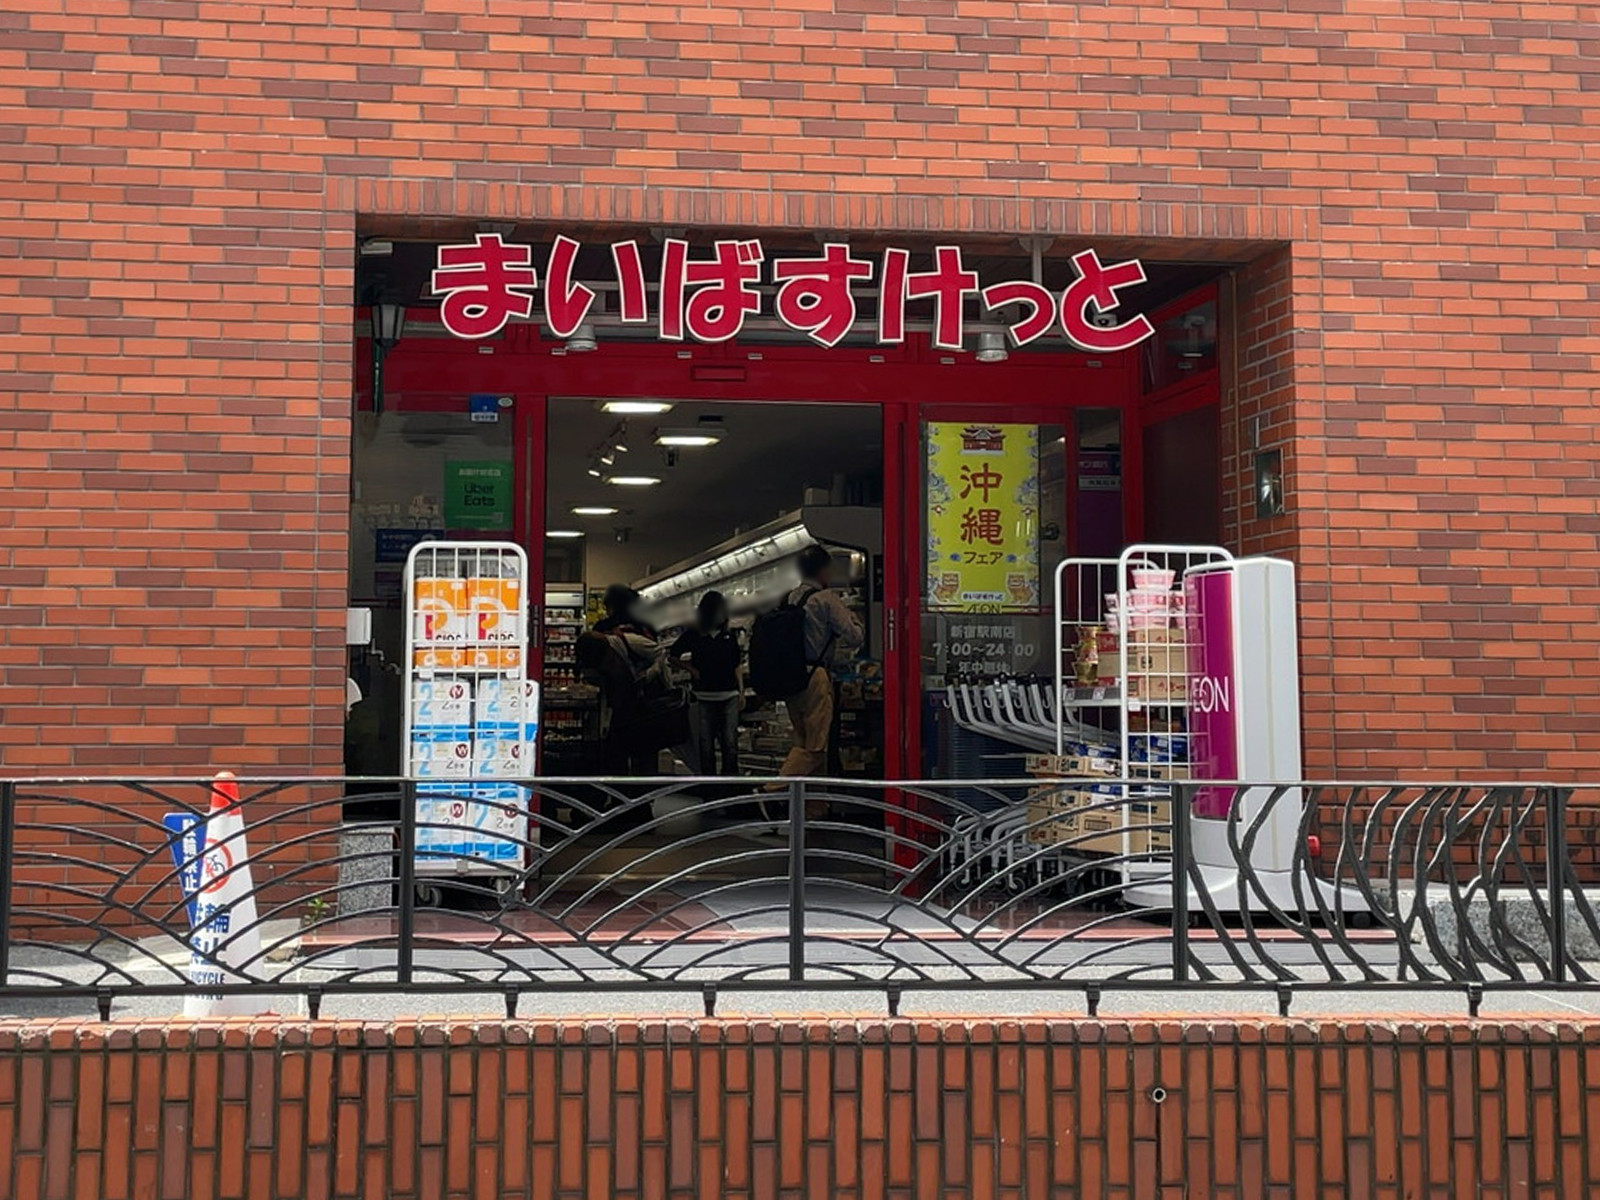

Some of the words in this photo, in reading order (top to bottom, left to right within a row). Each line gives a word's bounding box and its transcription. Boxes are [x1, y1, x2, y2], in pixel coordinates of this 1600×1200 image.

[432, 233, 1156, 352] まいばすけっと
[464, 483, 494, 494] Uber
[464, 495, 495, 506] Eats
[960, 463, 1003, 546] 沖縄
[963, 551, 1003, 564] フェア
